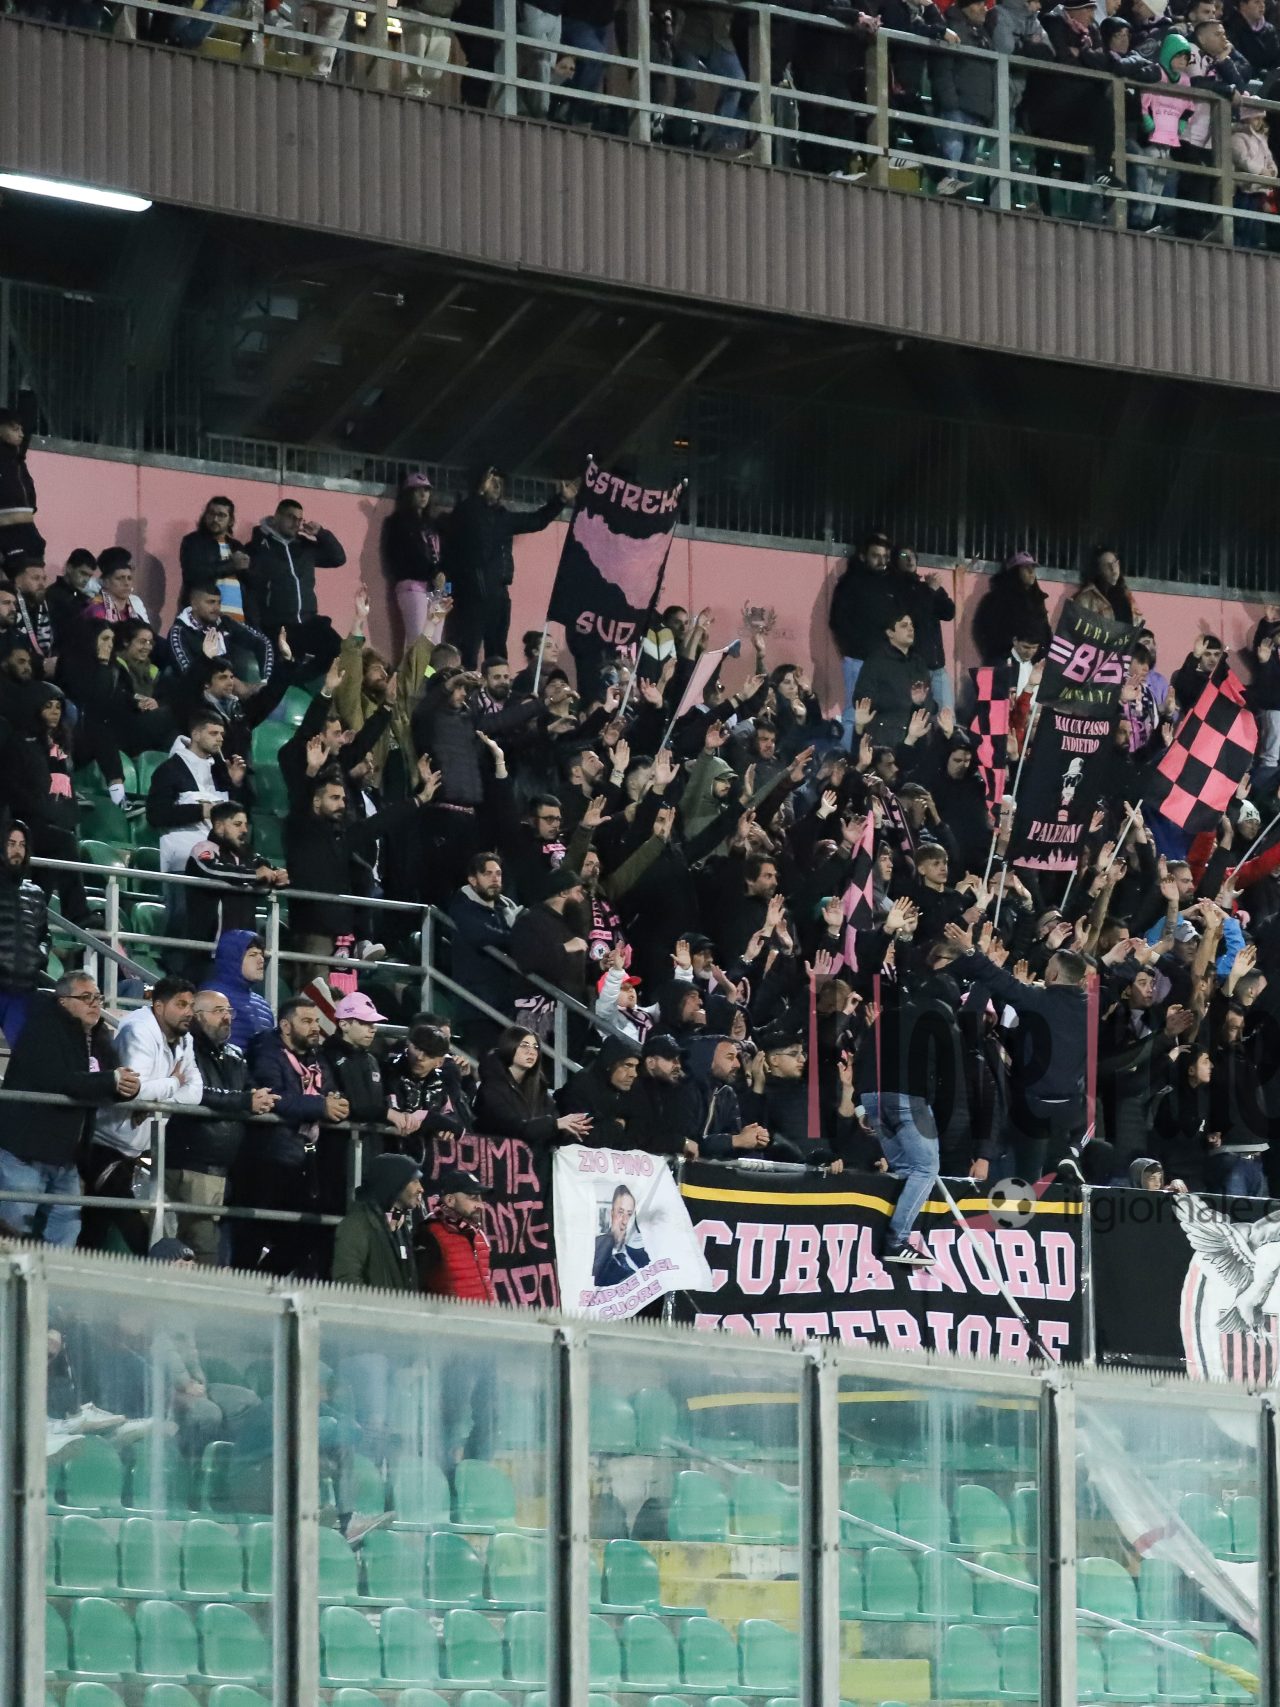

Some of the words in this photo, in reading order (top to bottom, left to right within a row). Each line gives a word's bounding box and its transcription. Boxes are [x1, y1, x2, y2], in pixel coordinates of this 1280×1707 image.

[585, 460, 683, 515] ESTREM
[575, 611, 637, 645] SUD
[1055, 715, 1070, 733] MAI
[1071, 719, 1084, 734] UN
[1083, 721, 1110, 735] PASSO
[1061, 735, 1100, 753] INDIETRO
[1027, 820, 1084, 844] PALERM
[579, 1150, 609, 1174] ZIO
[611, 1152, 655, 1177] PINO
[643, 1257, 680, 1283] NEL
[694, 1219, 895, 1296] CURVA
[907, 1228, 1076, 1301] NORD
[490, 1263, 561, 1311] OPO
[600, 1279, 663, 1320] CUORE
